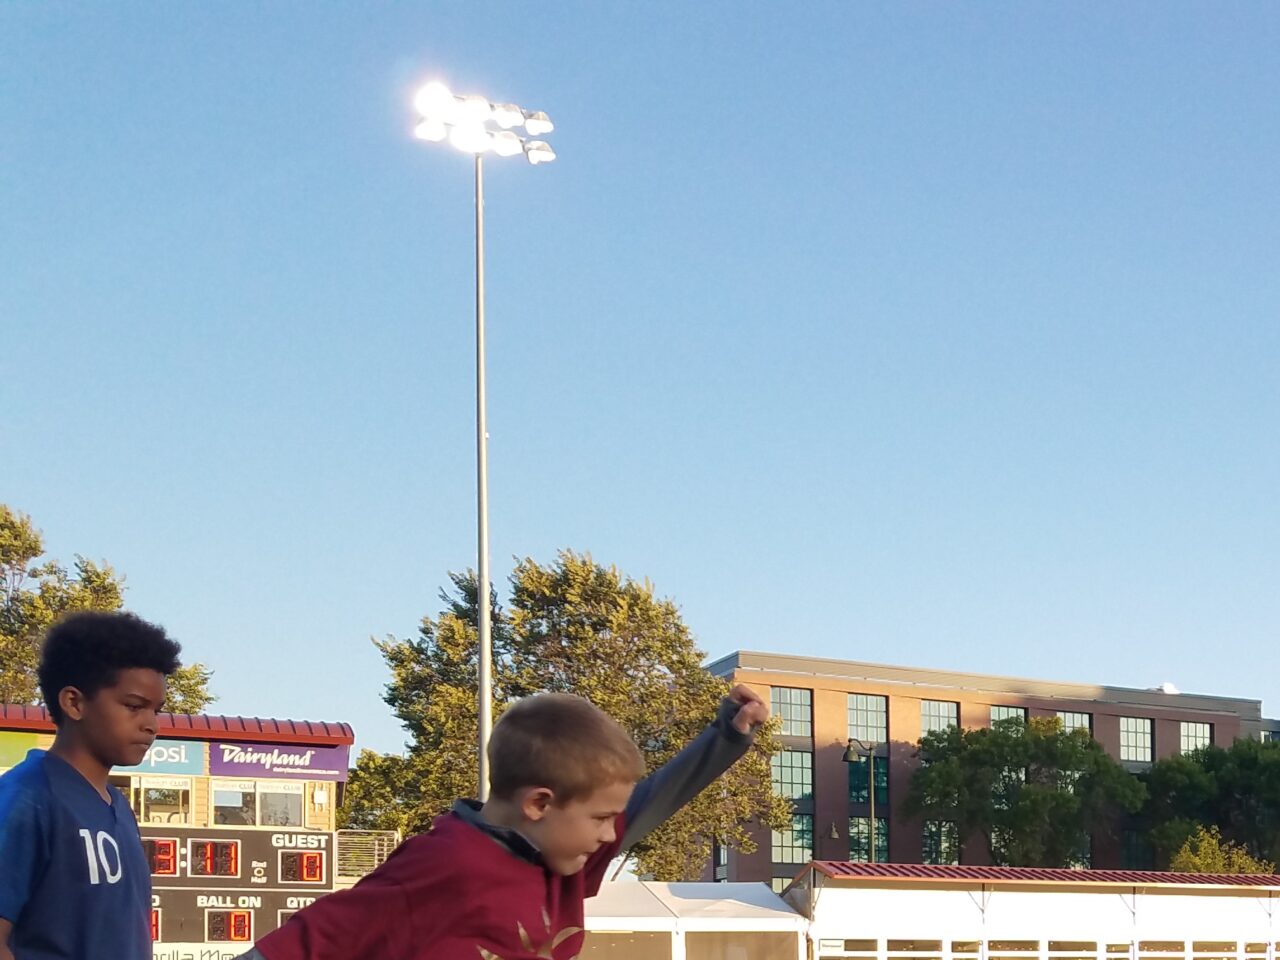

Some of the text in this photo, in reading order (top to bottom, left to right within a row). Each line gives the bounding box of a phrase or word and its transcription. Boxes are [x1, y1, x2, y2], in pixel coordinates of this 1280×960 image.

[219, 744, 312, 769] Dairyland
[271, 834, 329, 848] GUEST
[79, 828, 122, 885] 10
[302, 853, 320, 881] 0
[197, 895, 262, 908] BALL ON
[230, 911, 249, 941] 0
